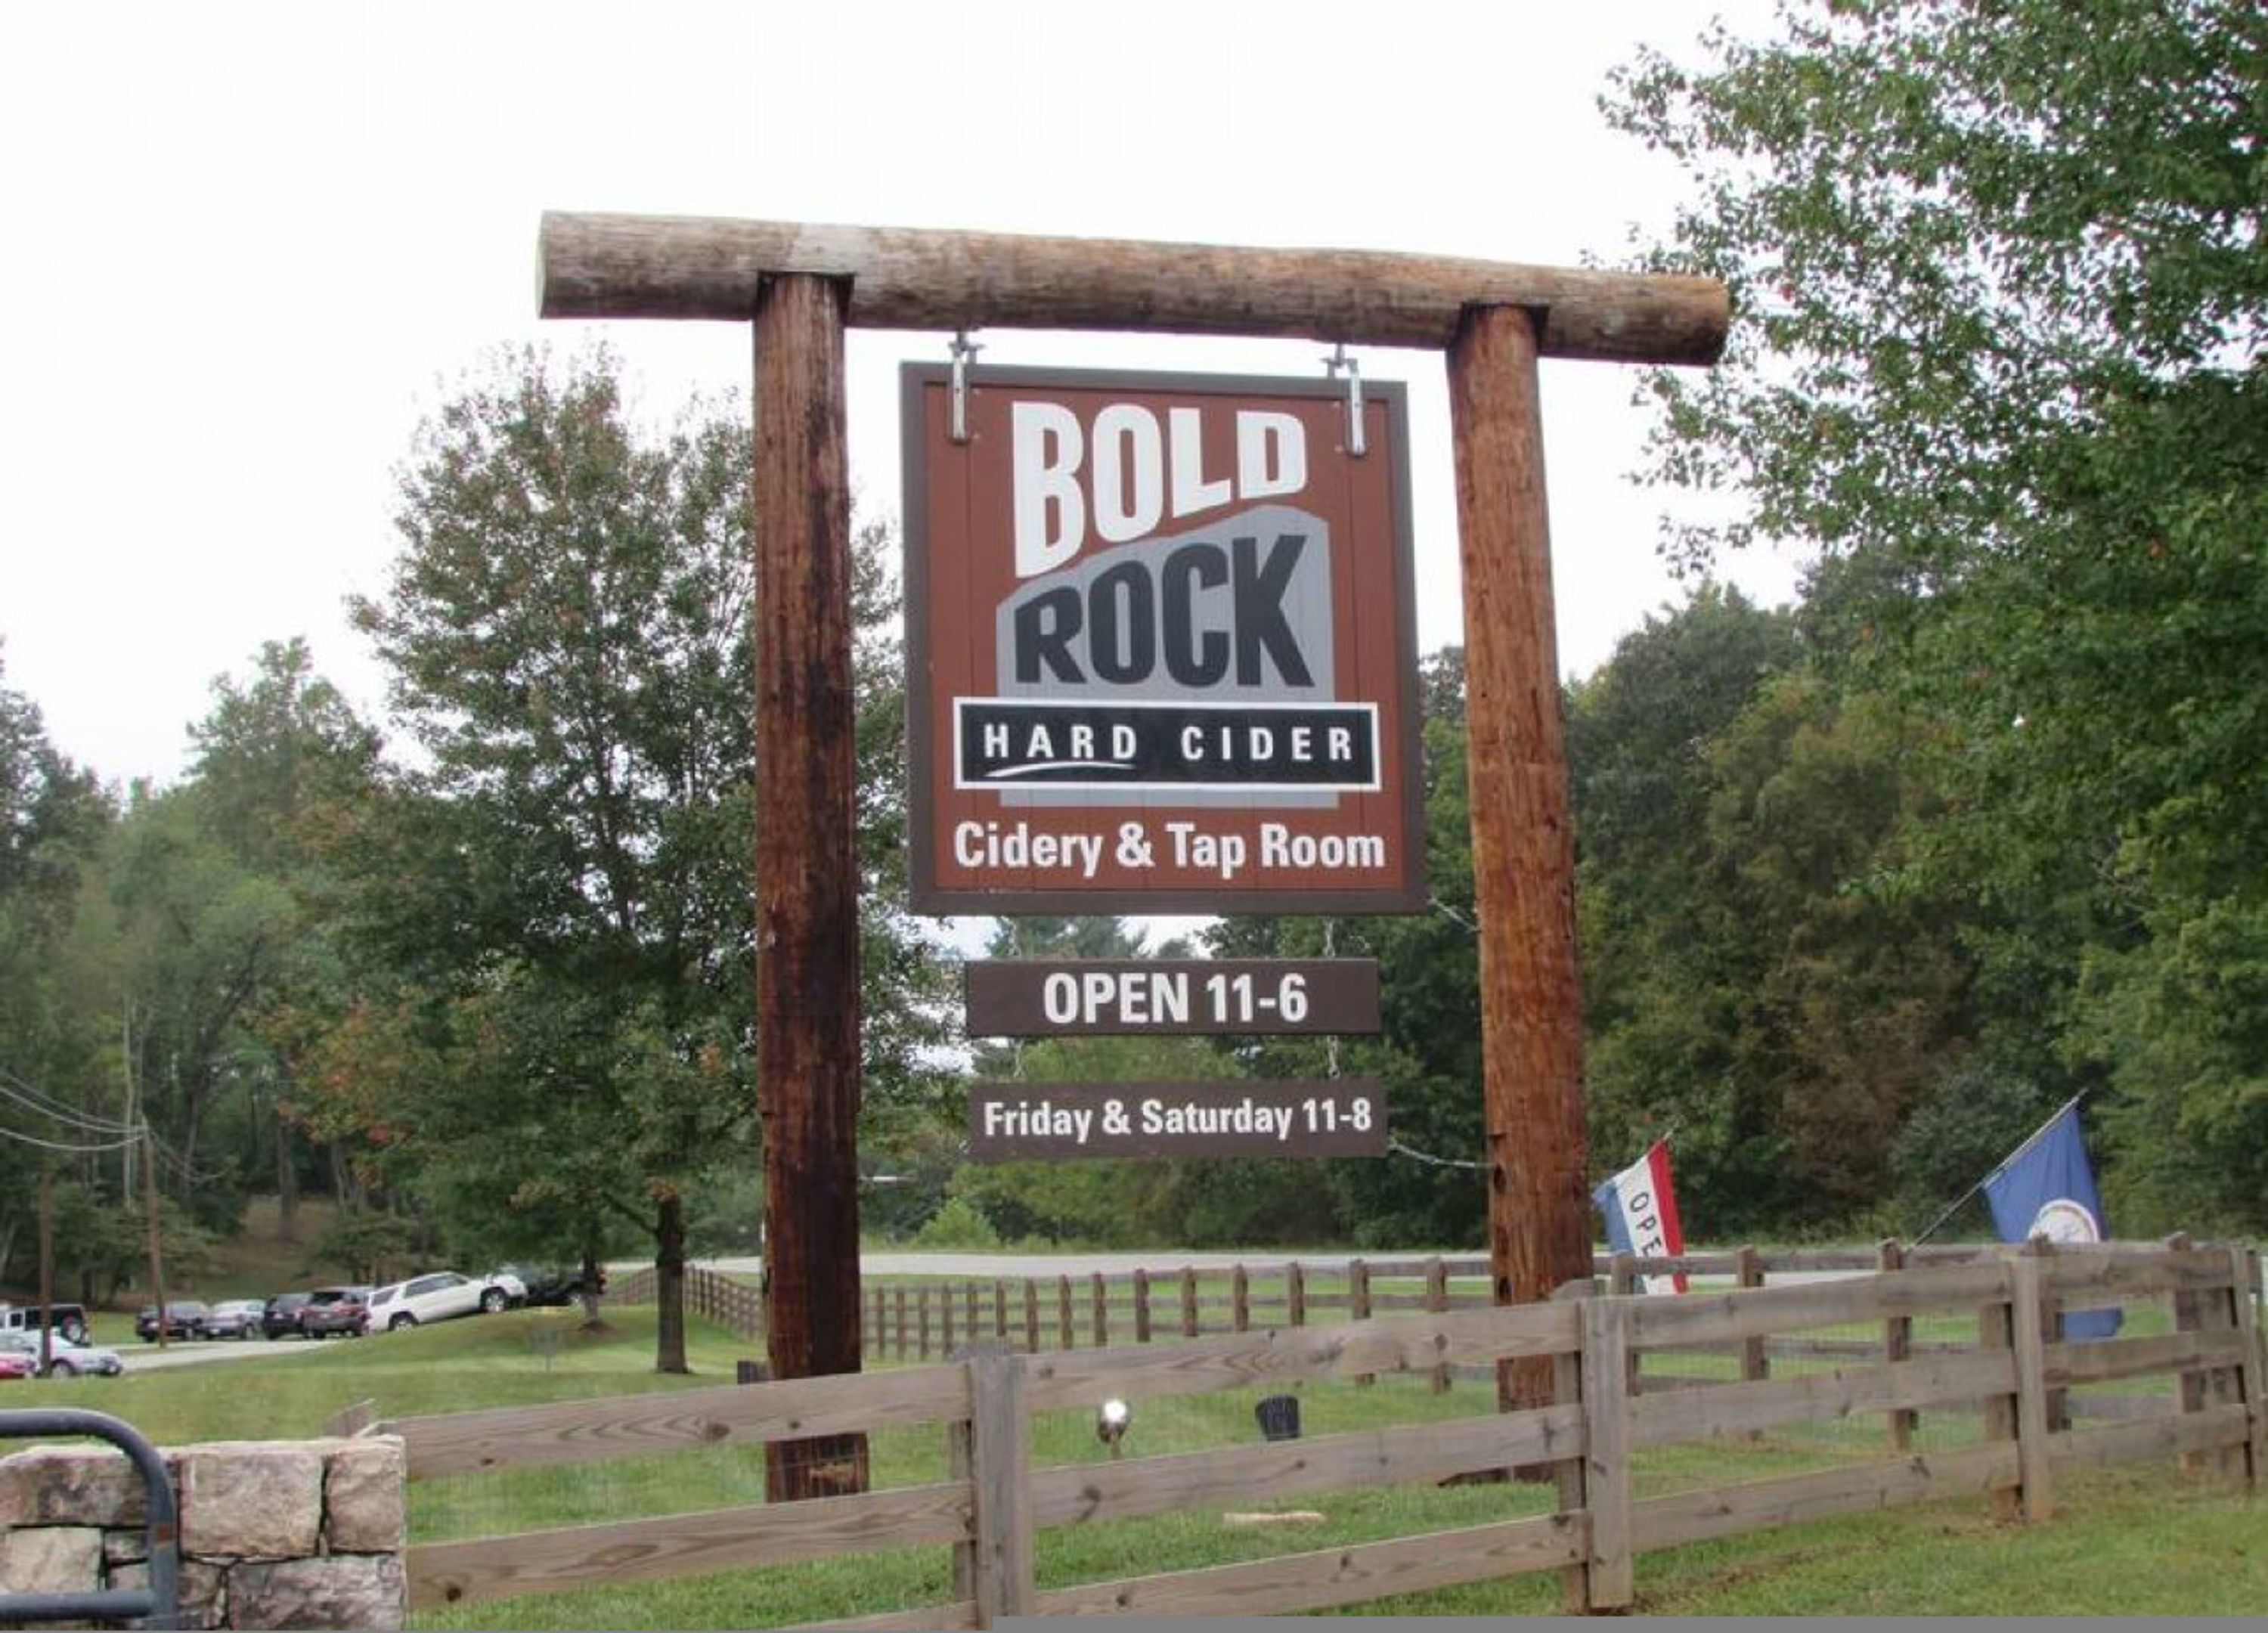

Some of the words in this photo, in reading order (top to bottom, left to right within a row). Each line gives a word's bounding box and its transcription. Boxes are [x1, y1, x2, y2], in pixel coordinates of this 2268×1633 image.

[1012, 401, 1309, 578] BOLD
[1014, 534, 1315, 688] ROCK
[984, 724, 1137, 760] HARD
[1180, 726, 1352, 761] CIDER
[953, 820, 1104, 878] Cidery
[1115, 821, 1156, 869] &
[1165, 823, 1247, 879] Tap
[1260, 823, 1385, 869] Room
[1043, 971, 1189, 1024] OPEN
[1206, 972, 1309, 1023] 11-6
[984, 1100, 1092, 1144] Friday
[1101, 1098, 1132, 1136] &
[1142, 1097, 1293, 1141] Saturday
[1302, 1097, 1373, 1133] 11-8
[1630, 1191, 1662, 1279] OPE
